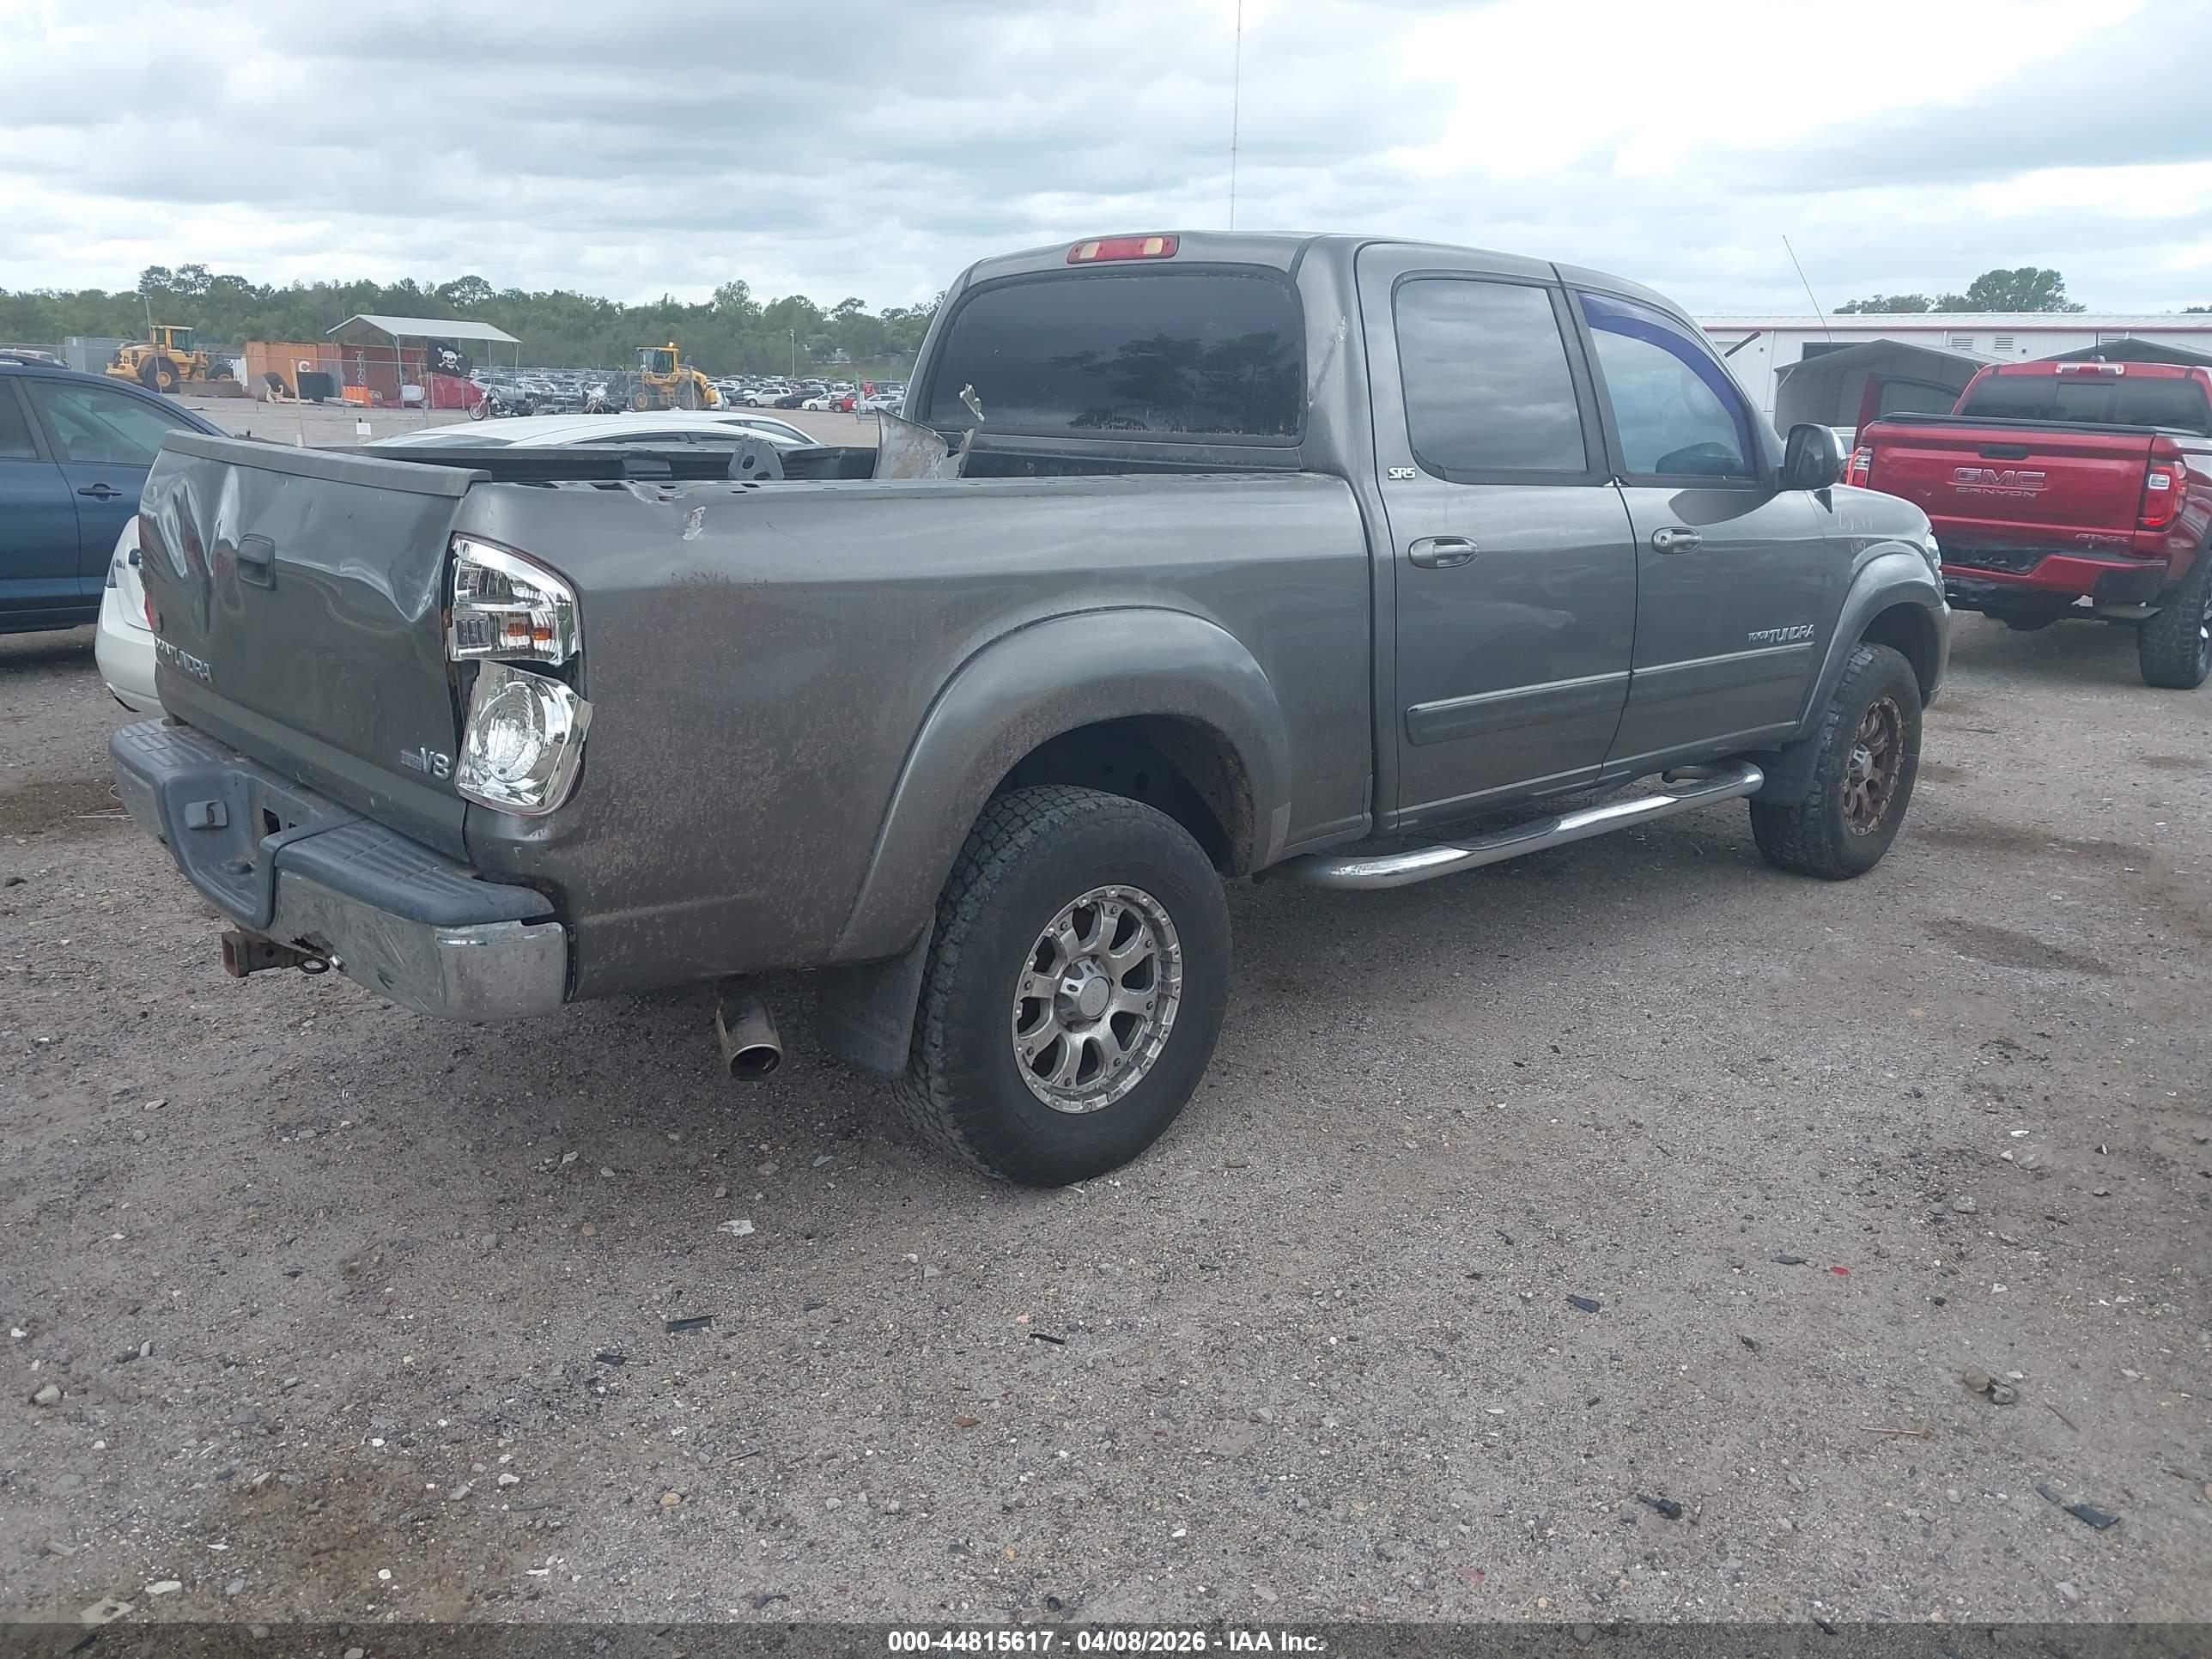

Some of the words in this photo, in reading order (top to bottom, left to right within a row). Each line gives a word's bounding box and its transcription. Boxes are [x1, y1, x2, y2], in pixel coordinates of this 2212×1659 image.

[1389, 467, 1416, 479] SR5
[1953, 467, 2046, 488] GMC
[1955, 487, 2038, 498] CANYON
[1769, 623, 1814, 643] TUNDRA
[420, 746, 451, 781] V8
